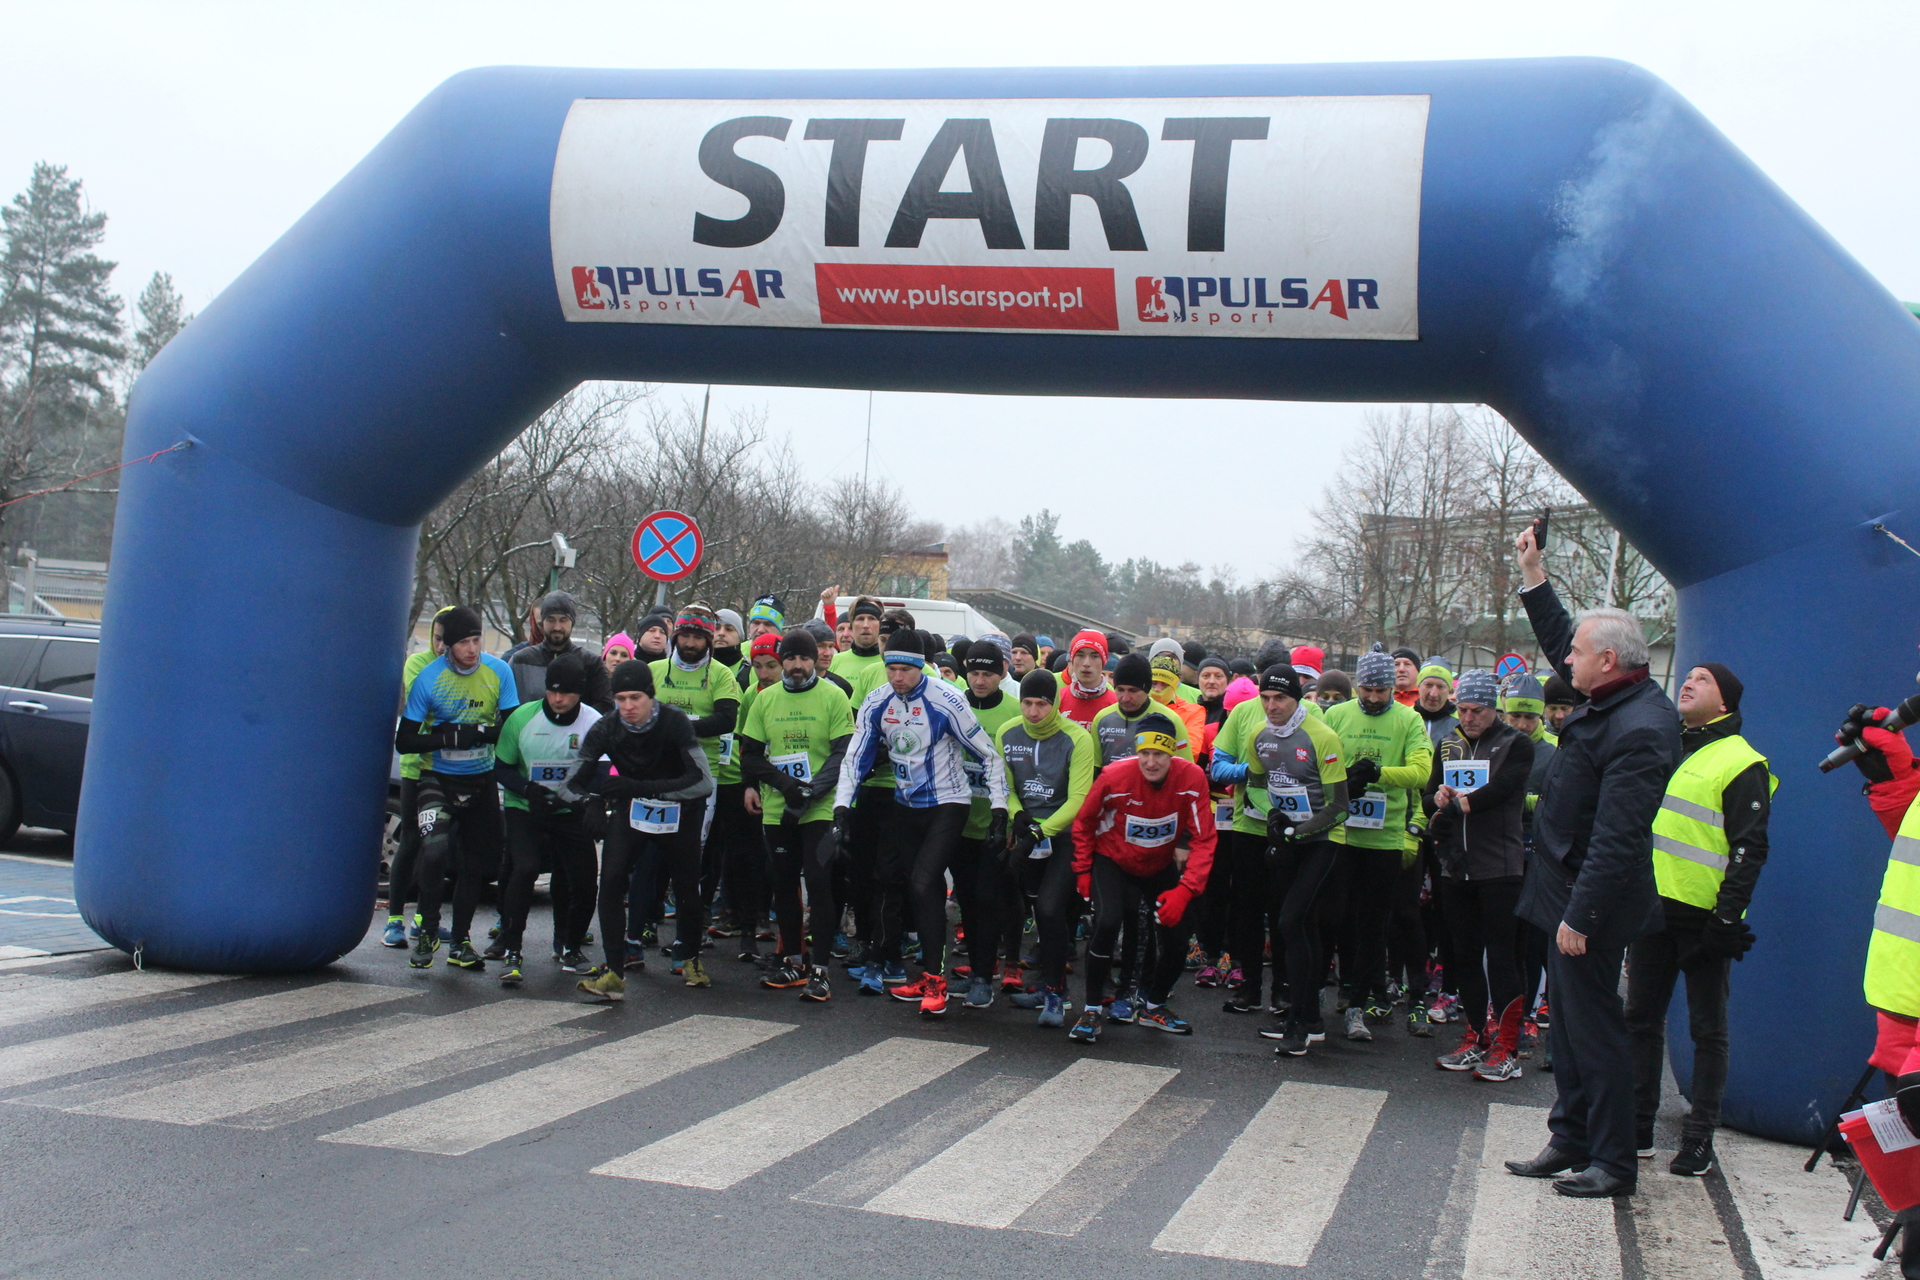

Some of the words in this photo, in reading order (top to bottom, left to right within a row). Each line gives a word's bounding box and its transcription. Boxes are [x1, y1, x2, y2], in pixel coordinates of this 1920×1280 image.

[693, 116, 1271, 252] START
[616, 266, 786, 308] PULSAR
[623, 299, 696, 313] sport
[836, 285, 1083, 312] www.pulsarsport.pl
[1187, 277, 1380, 321] PULSAR
[1191, 310, 1274, 325] sport
[942, 691, 965, 712] alpin
[541, 767, 568, 781] 83
[775, 762, 805, 778] 18
[1451, 770, 1476, 787] 13
[1023, 782, 1054, 796] ZGRun
[1275, 795, 1298, 811] 29
[1349, 799, 1374, 817] 30
[643, 805, 666, 823] 71
[1131, 823, 1172, 838] 293
